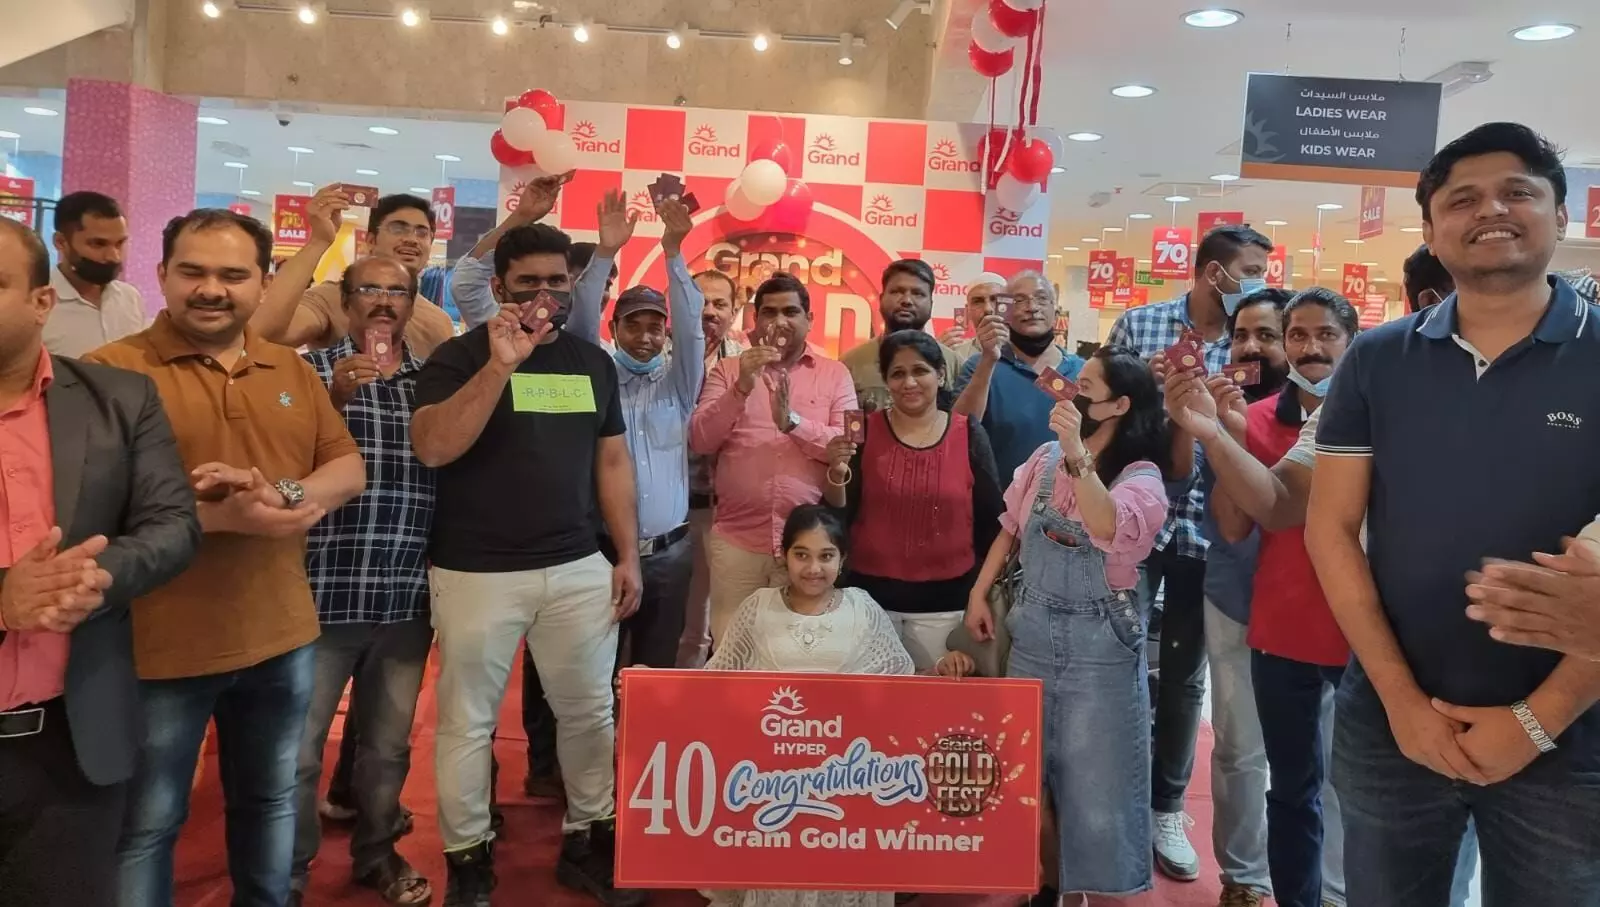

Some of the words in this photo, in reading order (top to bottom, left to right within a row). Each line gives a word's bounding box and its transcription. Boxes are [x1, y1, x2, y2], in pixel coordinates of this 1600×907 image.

[1295, 106, 1342, 119] LADIES
[1346, 109, 1387, 121] WEAR
[688, 143, 740, 158] Grand
[807, 150, 860, 167] Grand
[1300, 144, 1331, 156] KIDS
[1335, 147, 1376, 159] WEAR
[864, 211, 917, 228] Grand
[278, 229, 306, 239] SALE
[989, 221, 1042, 238] Grand
[1546, 411, 1582, 426] BOSS
[760, 714, 842, 738] Grand
[773, 742, 827, 756] HYPER
[938, 738, 984, 752] Grand
[928, 752, 993, 785] GOLD
[629, 740, 716, 837] 40
[727, 739, 926, 829] Congratulations
[937, 786, 984, 813] FEST
[713, 826, 791, 849] Gram
[801, 828, 867, 850] Gold
[876, 828, 985, 852] Winner
